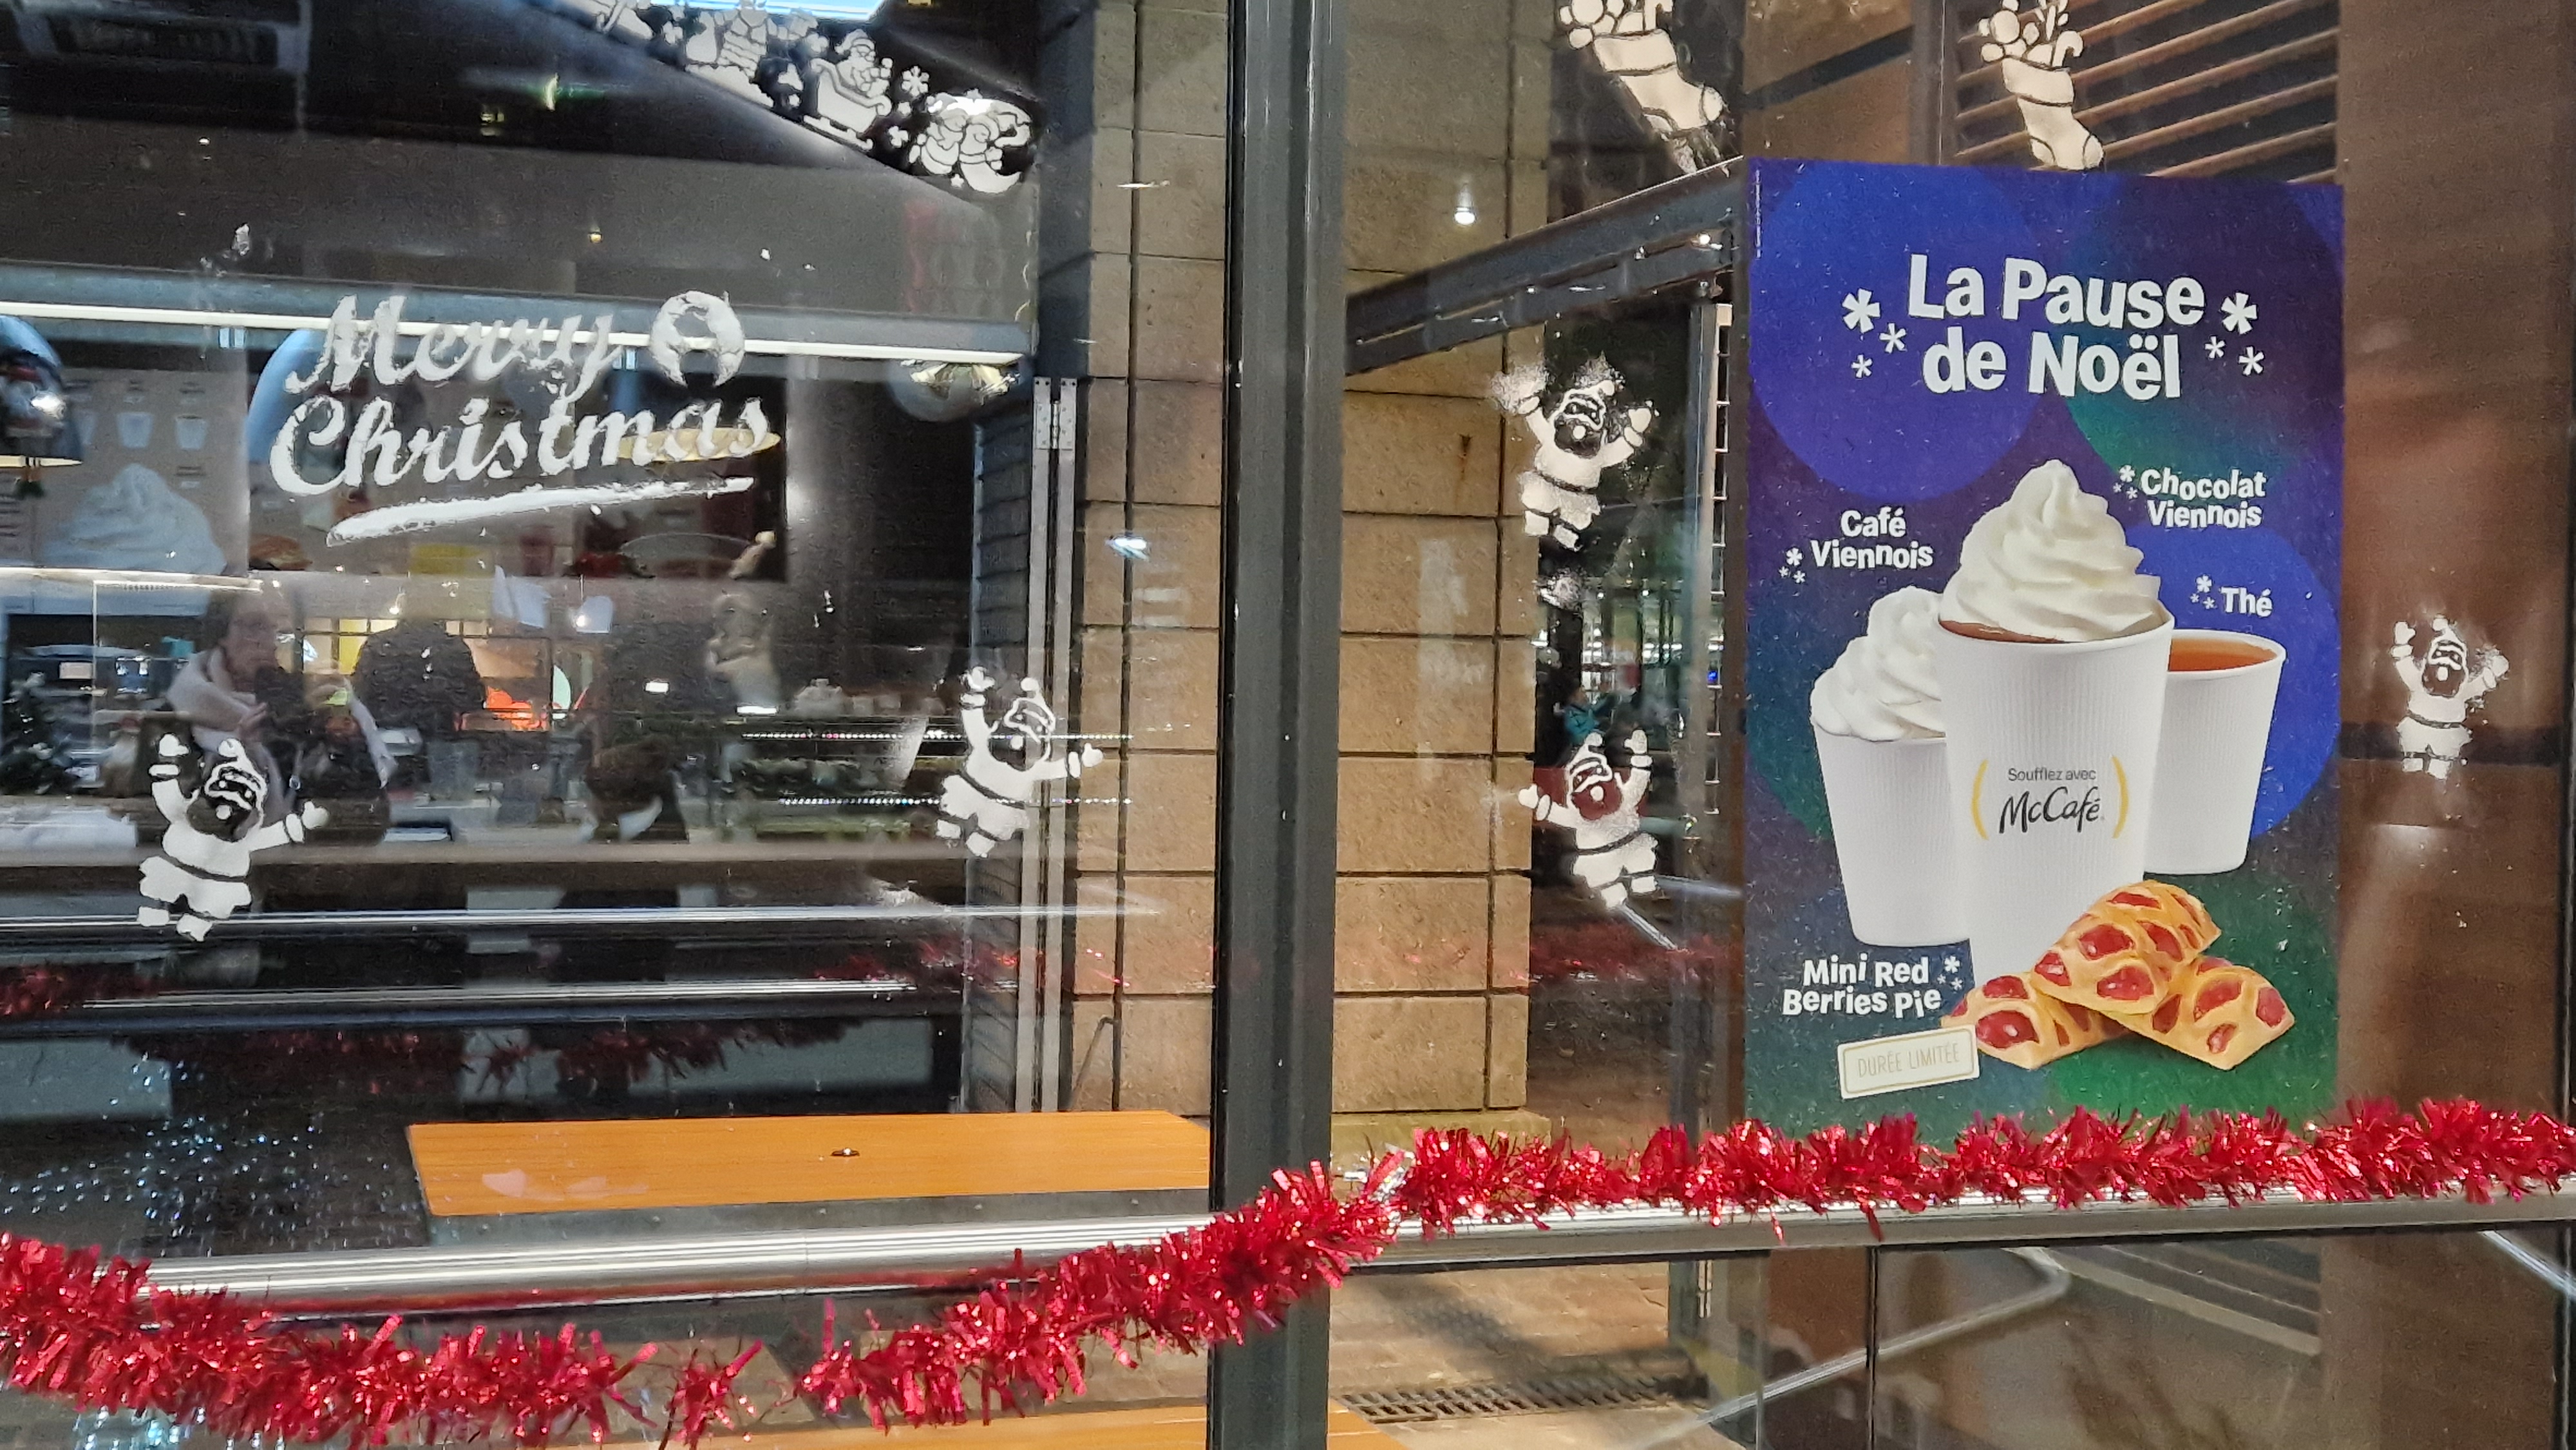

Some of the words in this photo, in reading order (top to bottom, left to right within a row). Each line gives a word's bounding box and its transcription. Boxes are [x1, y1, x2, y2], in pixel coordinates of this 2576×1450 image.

[1908, 254, 1985, 319] La
[2001, 257, 2206, 330] Pause
[285, 294, 622, 404] Merry
[1922, 326, 2007, 393] de
[2027, 331, 2182, 400] Noël
[269, 394, 770, 494] Christmas
[2140, 467, 2268, 500] Chocolat
[1841, 505, 1906, 538] Café
[2147, 500, 2262, 529] Viennois
[1810, 538, 1934, 569] Viennois
[2221, 587, 2273, 618] Thé
[2007, 767, 2063, 782] Soufflez
[2065, 769, 2098, 781] avec
[1999, 786, 2101, 834] McCafé
[1803, 953, 1868, 986] Mini
[1875, 956, 1929, 988] Red
[1783, 986, 1888, 1016] Berries
[1857, 1051, 1902, 1078] DURÉE
[1908, 1041, 1960, 1069] LIMITÉE
